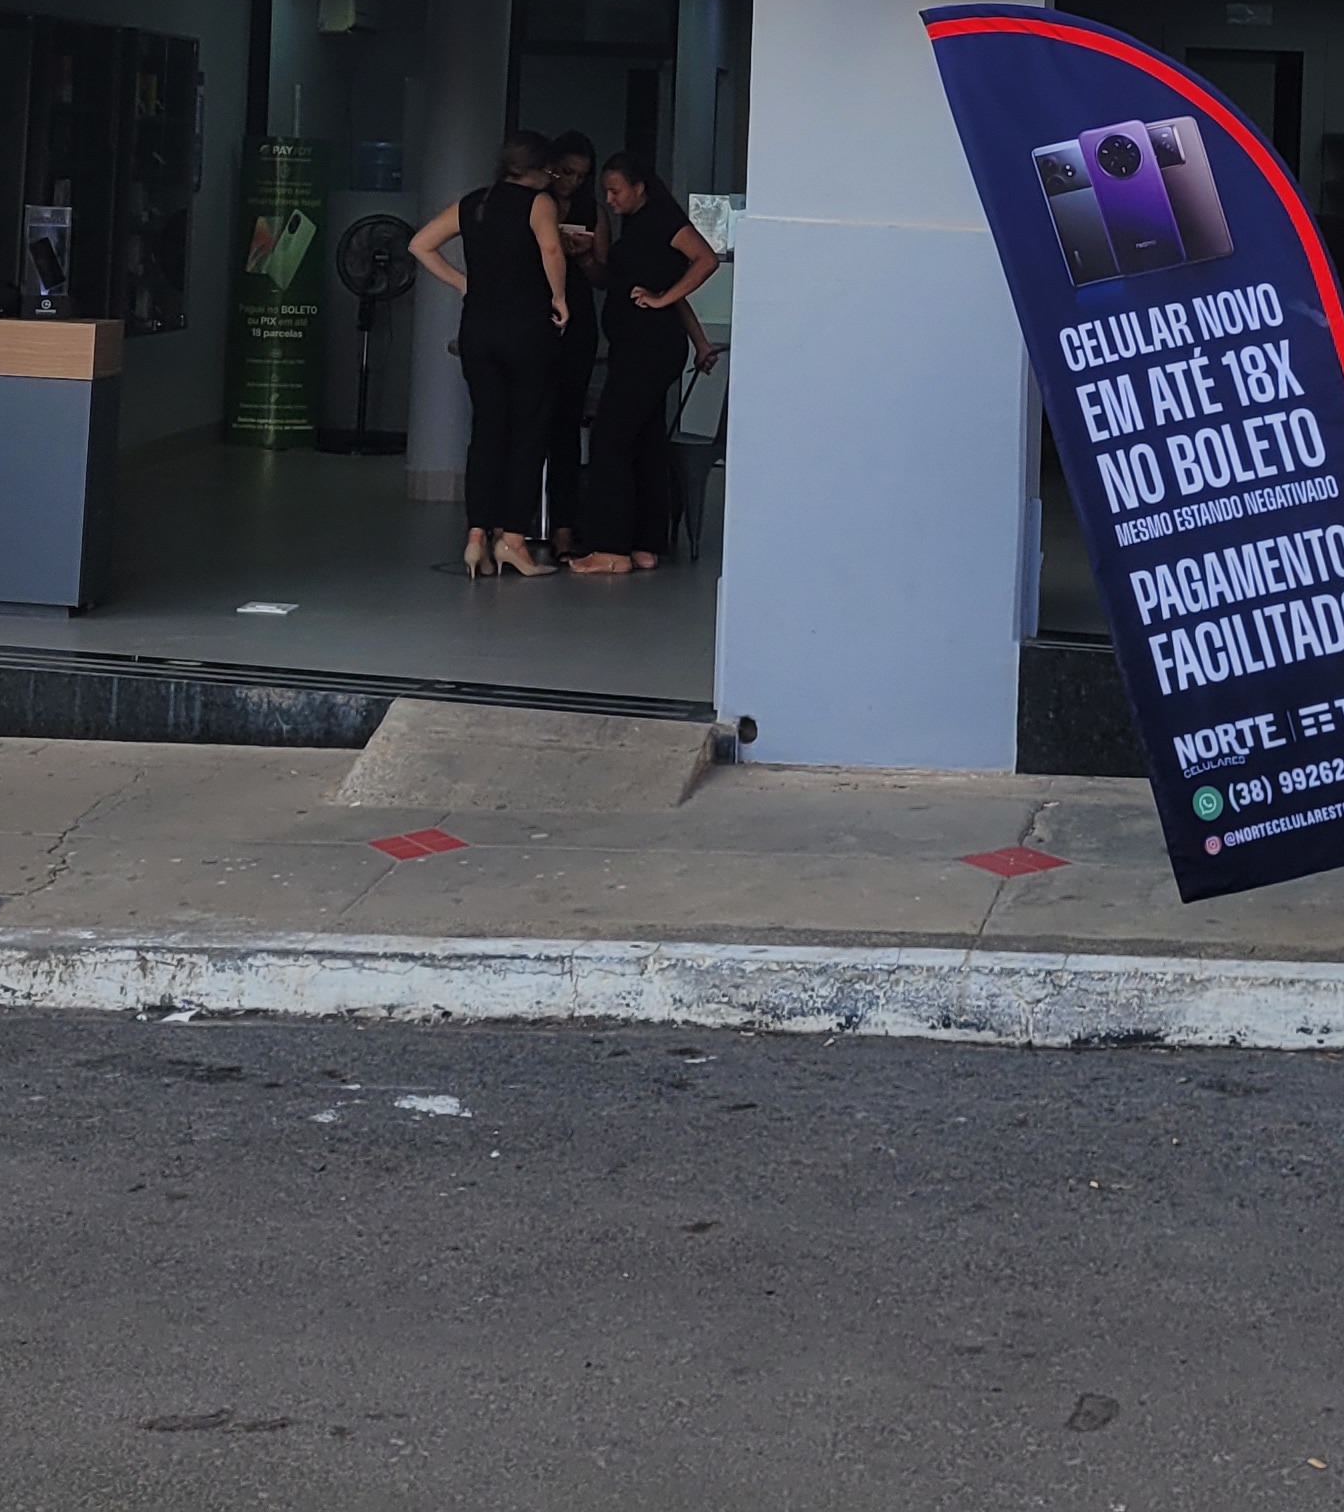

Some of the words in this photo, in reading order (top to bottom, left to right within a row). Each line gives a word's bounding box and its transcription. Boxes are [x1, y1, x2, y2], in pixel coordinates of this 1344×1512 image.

[260, 316, 276, 325] PIX
[263, 329, 303, 338] parcelas
[281, 305, 318, 314] BOLETO
[1059, 302, 1194, 372] CELULAR
[1191, 282, 1284, 340] NOVO
[1075, 373, 1145, 443] EM
[1148, 346, 1224, 427] ATÉ
[1221, 339, 1305, 407] 18X
[1096, 443, 1166, 514] NO
[1166, 407, 1327, 496] BOLETO
[1114, 511, 1174, 548] MESMO
[1173, 494, 1244, 532] ESTANDO
[1243, 474, 1339, 516] NEGATIVADO
[1173, 712, 1287, 771] NORTE
[1183, 755, 1246, 779] CELULARES
[1228, 775, 1273, 813] (38)
